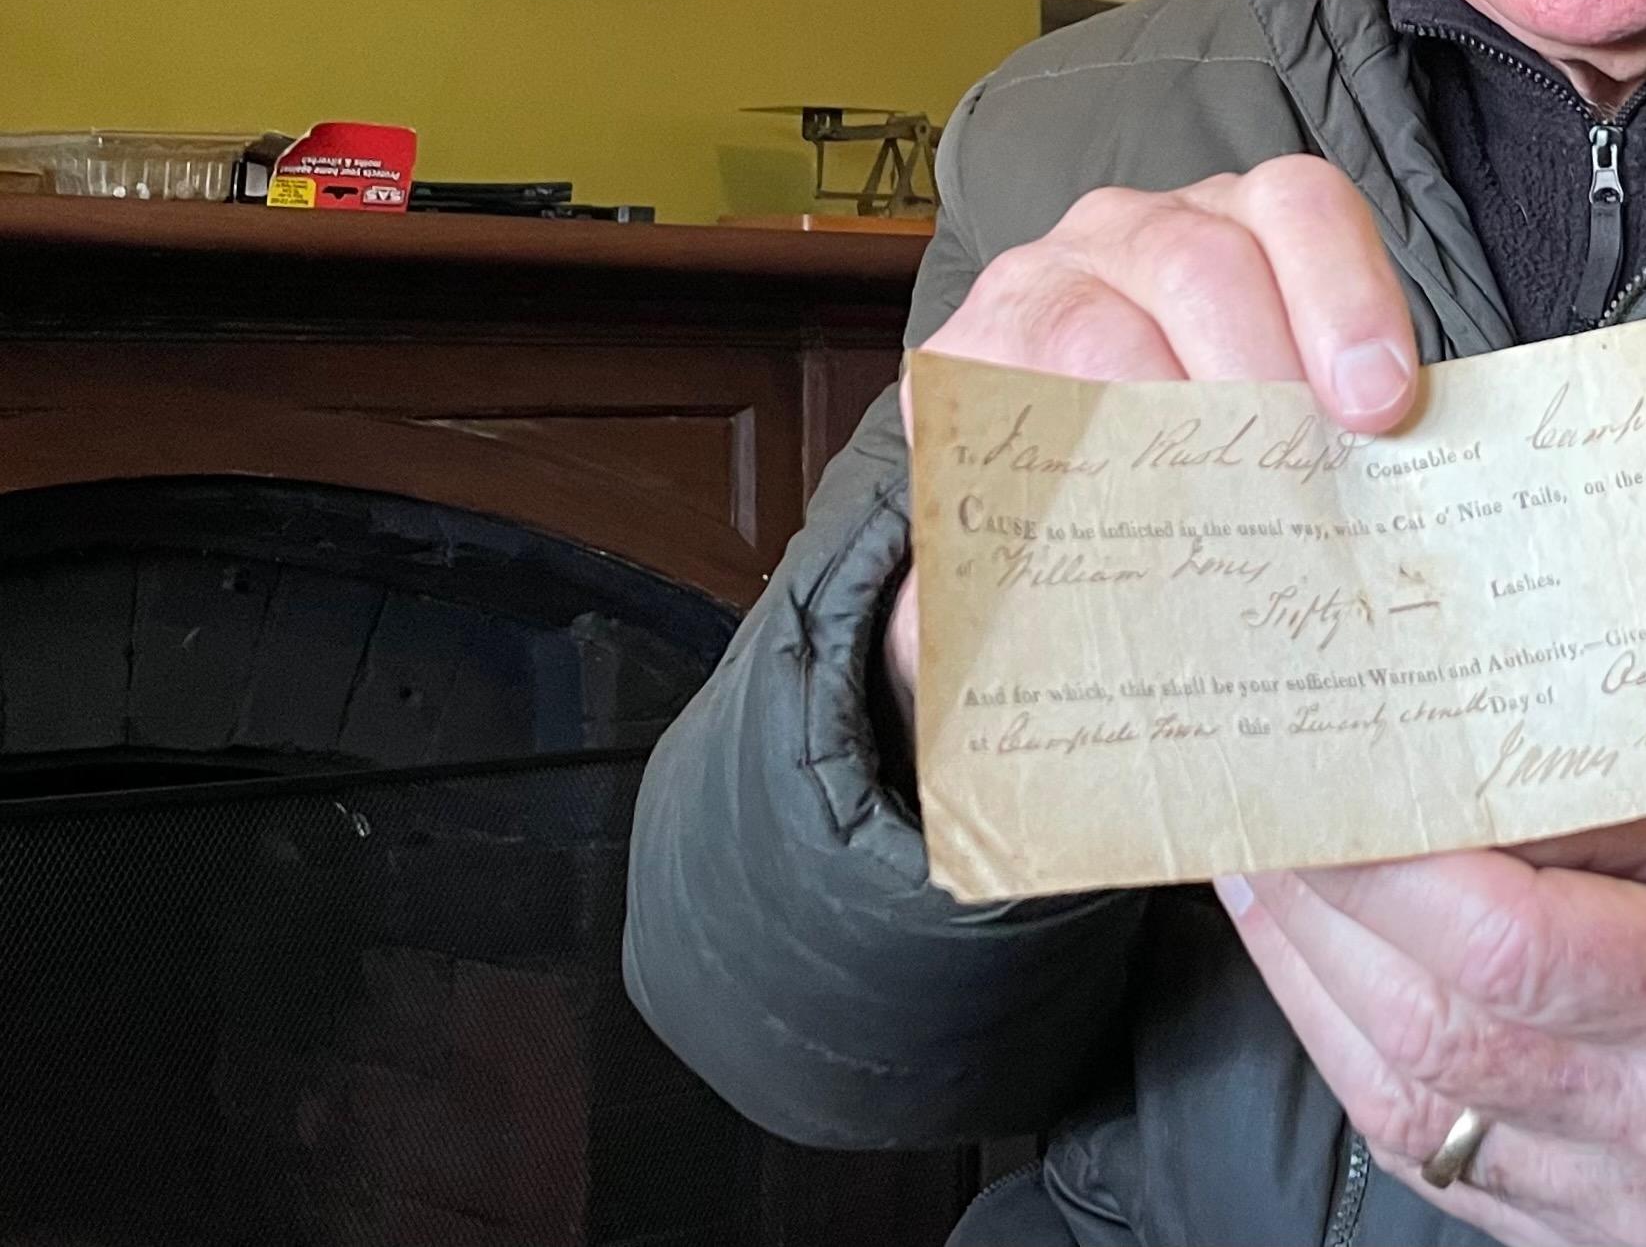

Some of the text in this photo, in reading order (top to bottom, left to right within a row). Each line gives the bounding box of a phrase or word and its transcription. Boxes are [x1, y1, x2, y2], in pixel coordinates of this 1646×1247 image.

[1366, 446, 1457, 479] Constable
[1463, 441, 1481, 460] of
[1047, 524, 1066, 540] to
[1071, 521, 1096, 540] be
[1101, 516, 1175, 540] inflicted
[1180, 521, 1199, 538] in
[1203, 519, 1232, 537] the
[1237, 517, 1284, 537] usual
[1292, 523, 1329, 541] way,
[1332, 518, 1370, 537] with
[1376, 524, 1387, 535] a
[1393, 512, 1426, 532] Cat
[1457, 498, 1504, 523] Nine
[1511, 486, 1569, 511] Tails,
[1584, 480, 1606, 497] on
[1615, 469, 1644, 491] the
[964, 686, 1007, 705] And
[1013, 684, 1041, 703] for
[1049, 680, 1113, 704] which,
[1120, 678, 1156, 698] this
[1161, 675, 1206, 698] shall
[1212, 674, 1235, 694] be
[1239, 676, 1280, 697] your
[1286, 671, 1366, 693] sufficient
[1368, 664, 1445, 688] Warrant
[1449, 657, 1482, 679] and
[969, 734, 989, 752] at
[1238, 717, 1272, 736] this
[1488, 691, 1530, 715] Day
[1535, 684, 1556, 705] of
